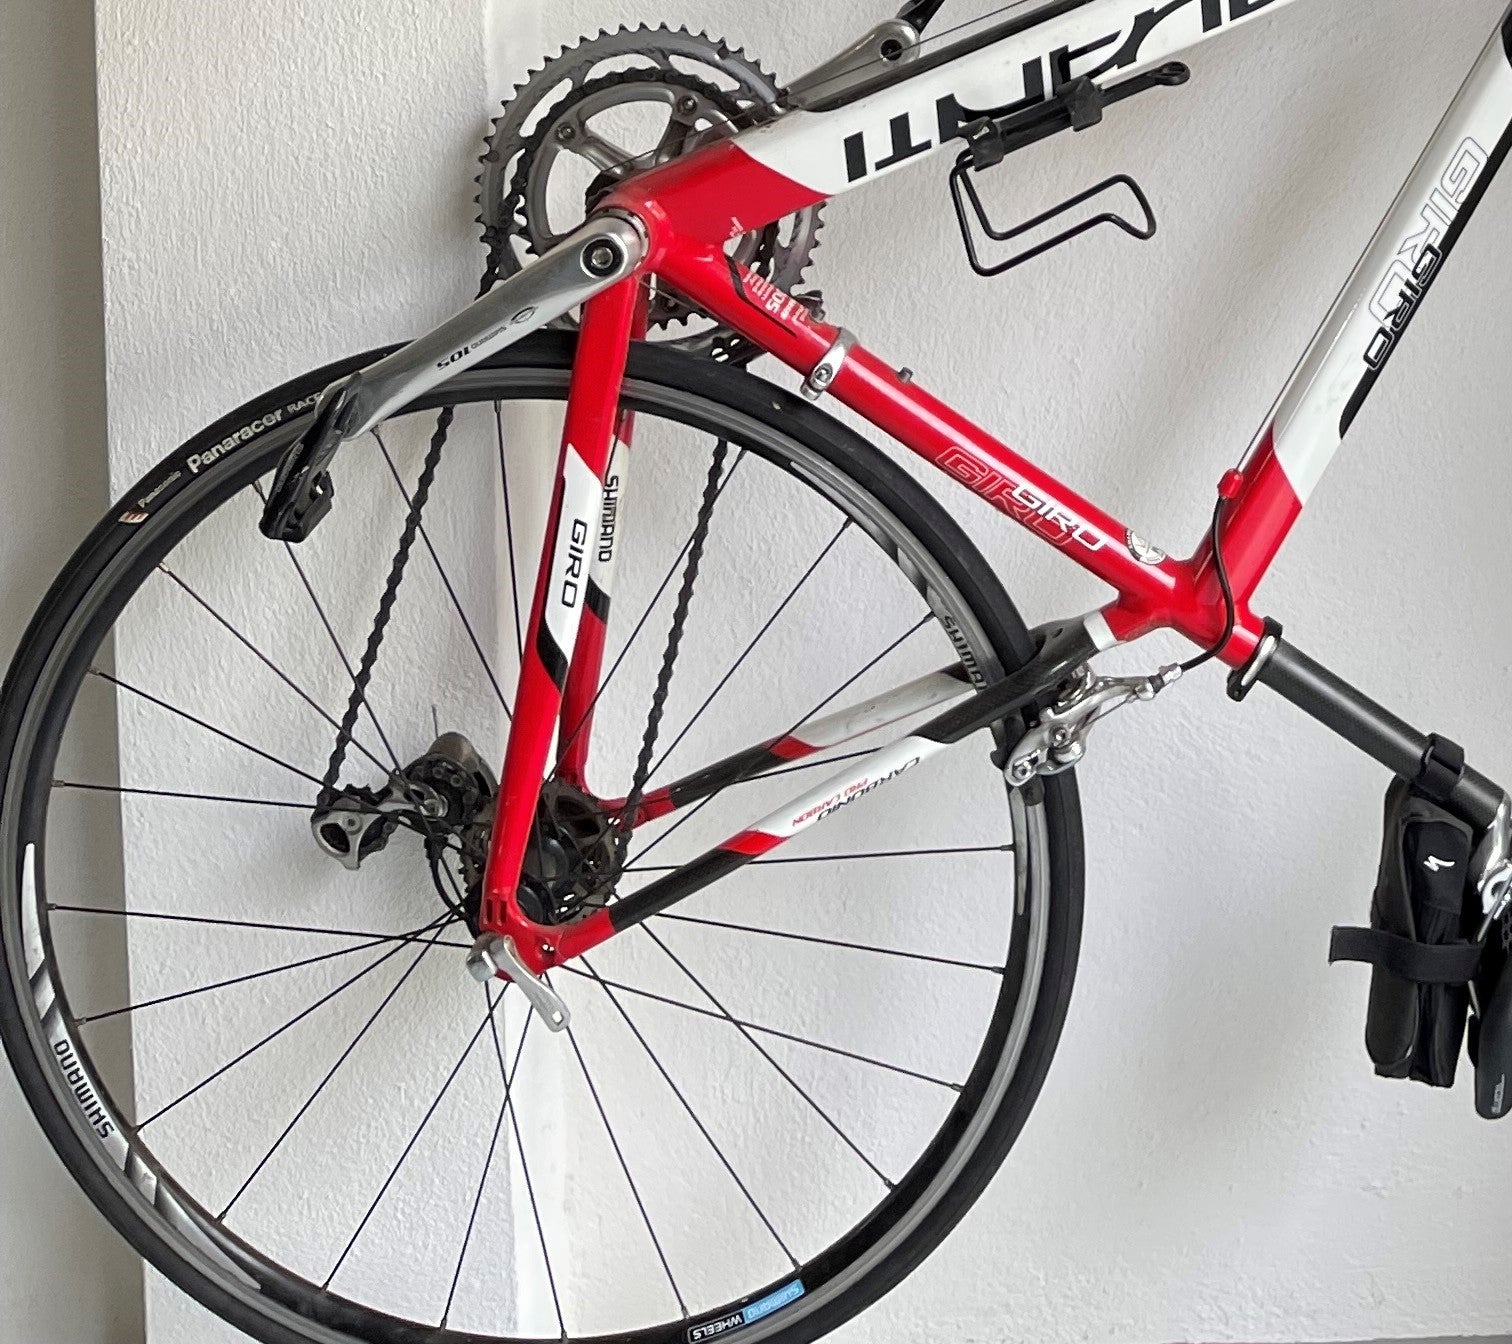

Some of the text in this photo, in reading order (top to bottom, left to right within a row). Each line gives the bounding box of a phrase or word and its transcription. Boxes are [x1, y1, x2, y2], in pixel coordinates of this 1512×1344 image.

[1363, 243, 1443, 370] GIRO
[436, 346, 471, 371] 105
[187, 409, 283, 474] Panaracer
[598, 465, 619, 562] SHIMANO
[1012, 483, 1110, 552] GIRO
[561, 518, 588, 609] GIRO
[944, 615, 987, 691] SHIMA
[53, 1039, 115, 1139] SHIMANO
[692, 1314, 743, 1340] WHEELS
